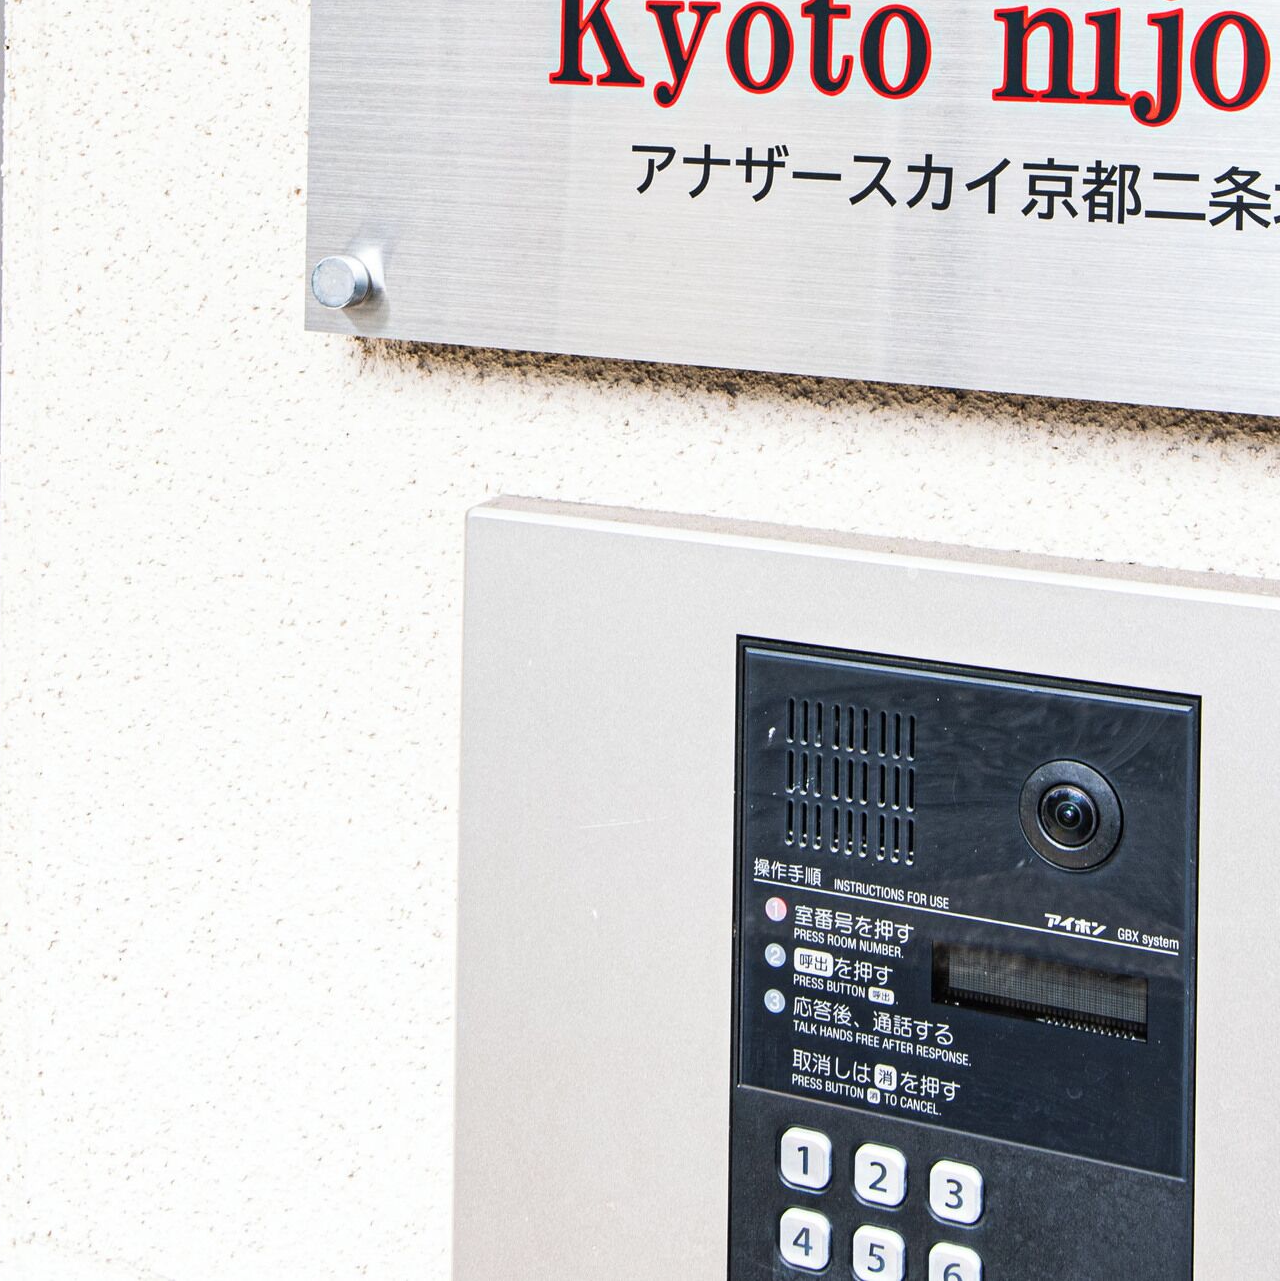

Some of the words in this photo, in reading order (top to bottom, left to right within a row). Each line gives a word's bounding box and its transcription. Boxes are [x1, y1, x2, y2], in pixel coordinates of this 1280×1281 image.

[753, 857, 822, 887] 操作手順
[834, 878, 905, 902] INSTRUCTIONS
[907, 890, 927, 905] FOR
[929, 896, 950, 910] USE
[794, 904, 915, 944] 室番号を押す
[1044, 912, 1107, 936] アイホン
[1117, 927, 1140, 943] GBX
[1142, 933, 1180, 951] system
[794, 927, 825, 944] PRESS
[827, 934, 857, 950] ROOM
[859, 940, 904, 959] NUMBER.
[793, 973, 824, 992] PRESS
[826, 979, 866, 998] BUTTON
[793, 995, 954, 1046] 応答後、通話する
[793, 1019, 818, 1035] TALK
[820, 1026, 853, 1043] HANDS
[855, 1033, 880, 1048] FREE
[882, 1038, 914, 1055] AFTER
[916, 1045, 972, 1067] RESPONSE.
[791, 1073, 823, 1090] PRESS
[825, 1079, 864, 1099] BUTTON
[884, 1092, 898, 1106] TO
[900, 1097, 942, 1116] CANCEL.
[796, 1146, 810, 1176] 1
[868, 1161, 888, 1193] 2
[944, 1179, 964, 1210] 3
[792, 1226, 814, 1257] 4
[867, 1243, 887, 1273] 5
[943, 1262, 963, 1281] 6
